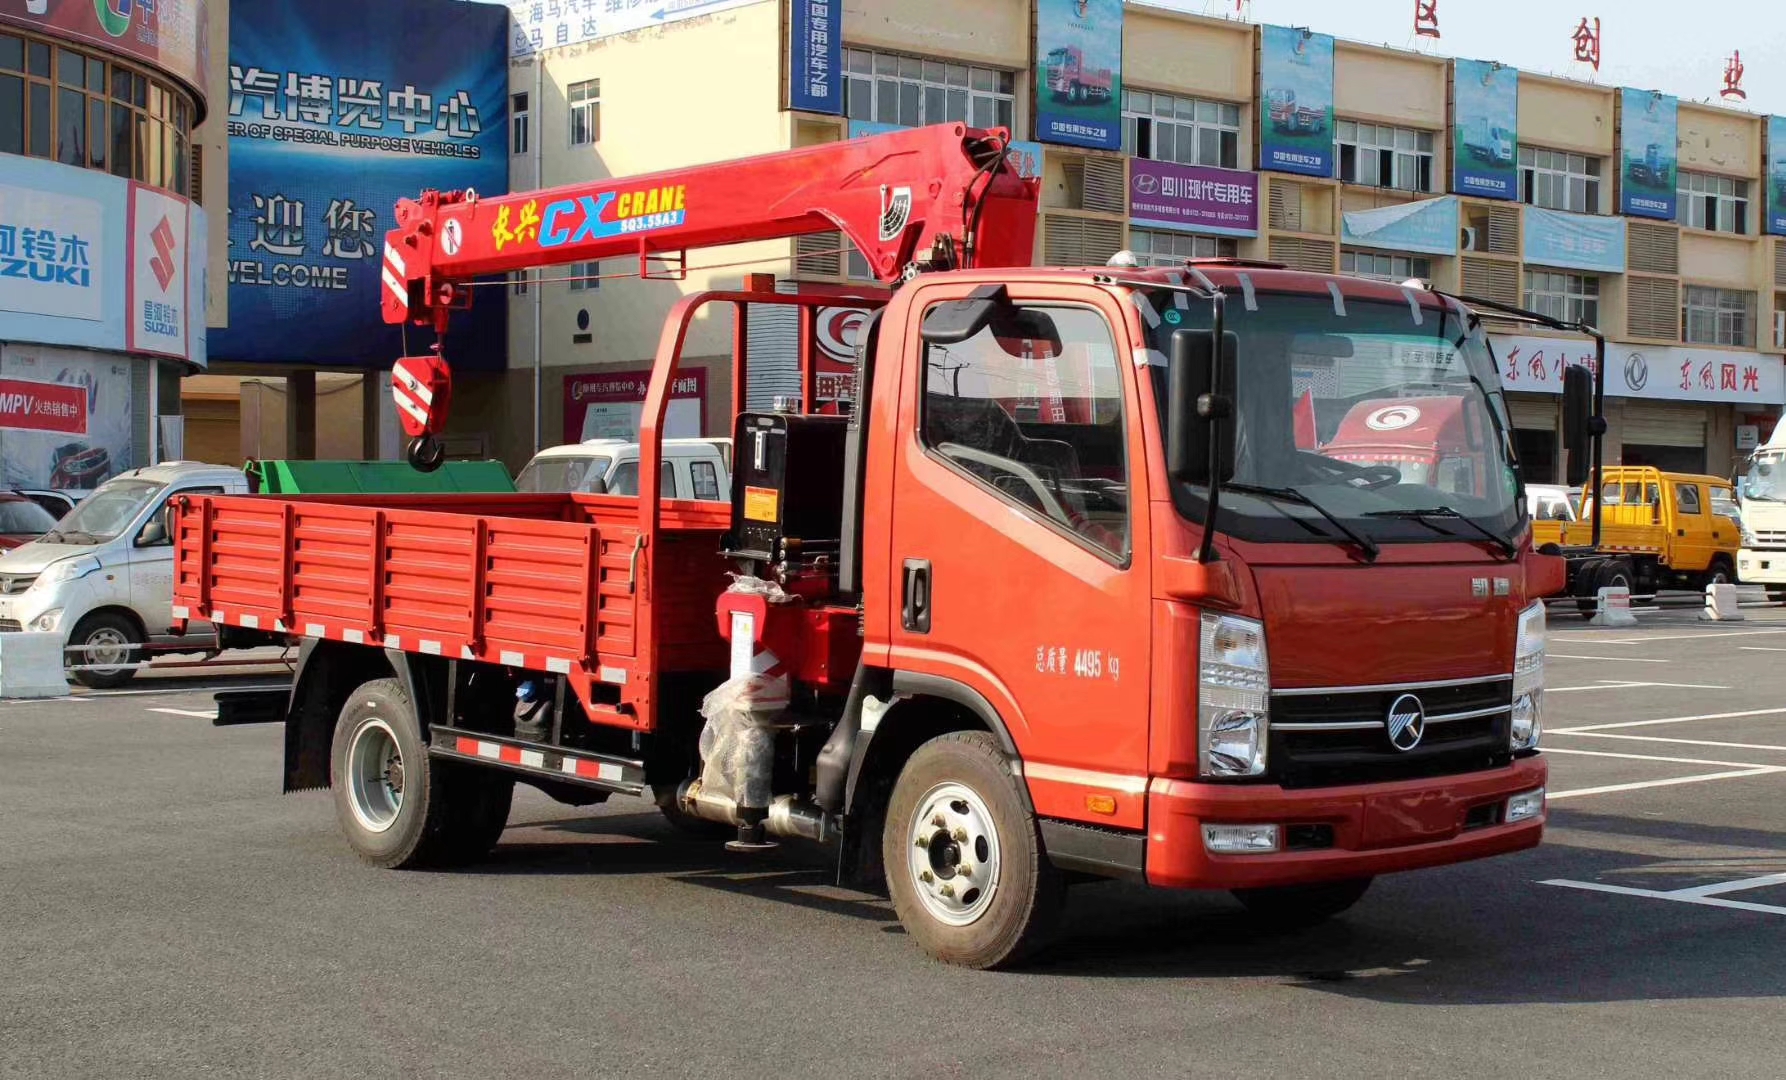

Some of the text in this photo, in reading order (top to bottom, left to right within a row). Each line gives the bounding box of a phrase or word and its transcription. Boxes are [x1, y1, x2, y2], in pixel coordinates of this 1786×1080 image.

[529, 16, 597, 48] 马自达
[810, 0, 829, 97] 国专用汽车之都
[229, 66, 481, 138] 汽博览中心
[249, 124, 271, 138] OF
[273, 126, 338, 146] SPECIAL
[341, 134, 409, 151] PURPOSE
[411, 140, 480, 158] VEHICLES
[1161, 176, 1253, 205] 四川现代专用车
[228, 193, 376, 259] 迎您
[538, 190, 616, 248] CX
[617, 184, 686, 219] CRANE
[144, 320, 179, 337] SUZUKI
[1035, 645, 1067, 675] 总质量
[1074, 649, 1101, 677] 4495
